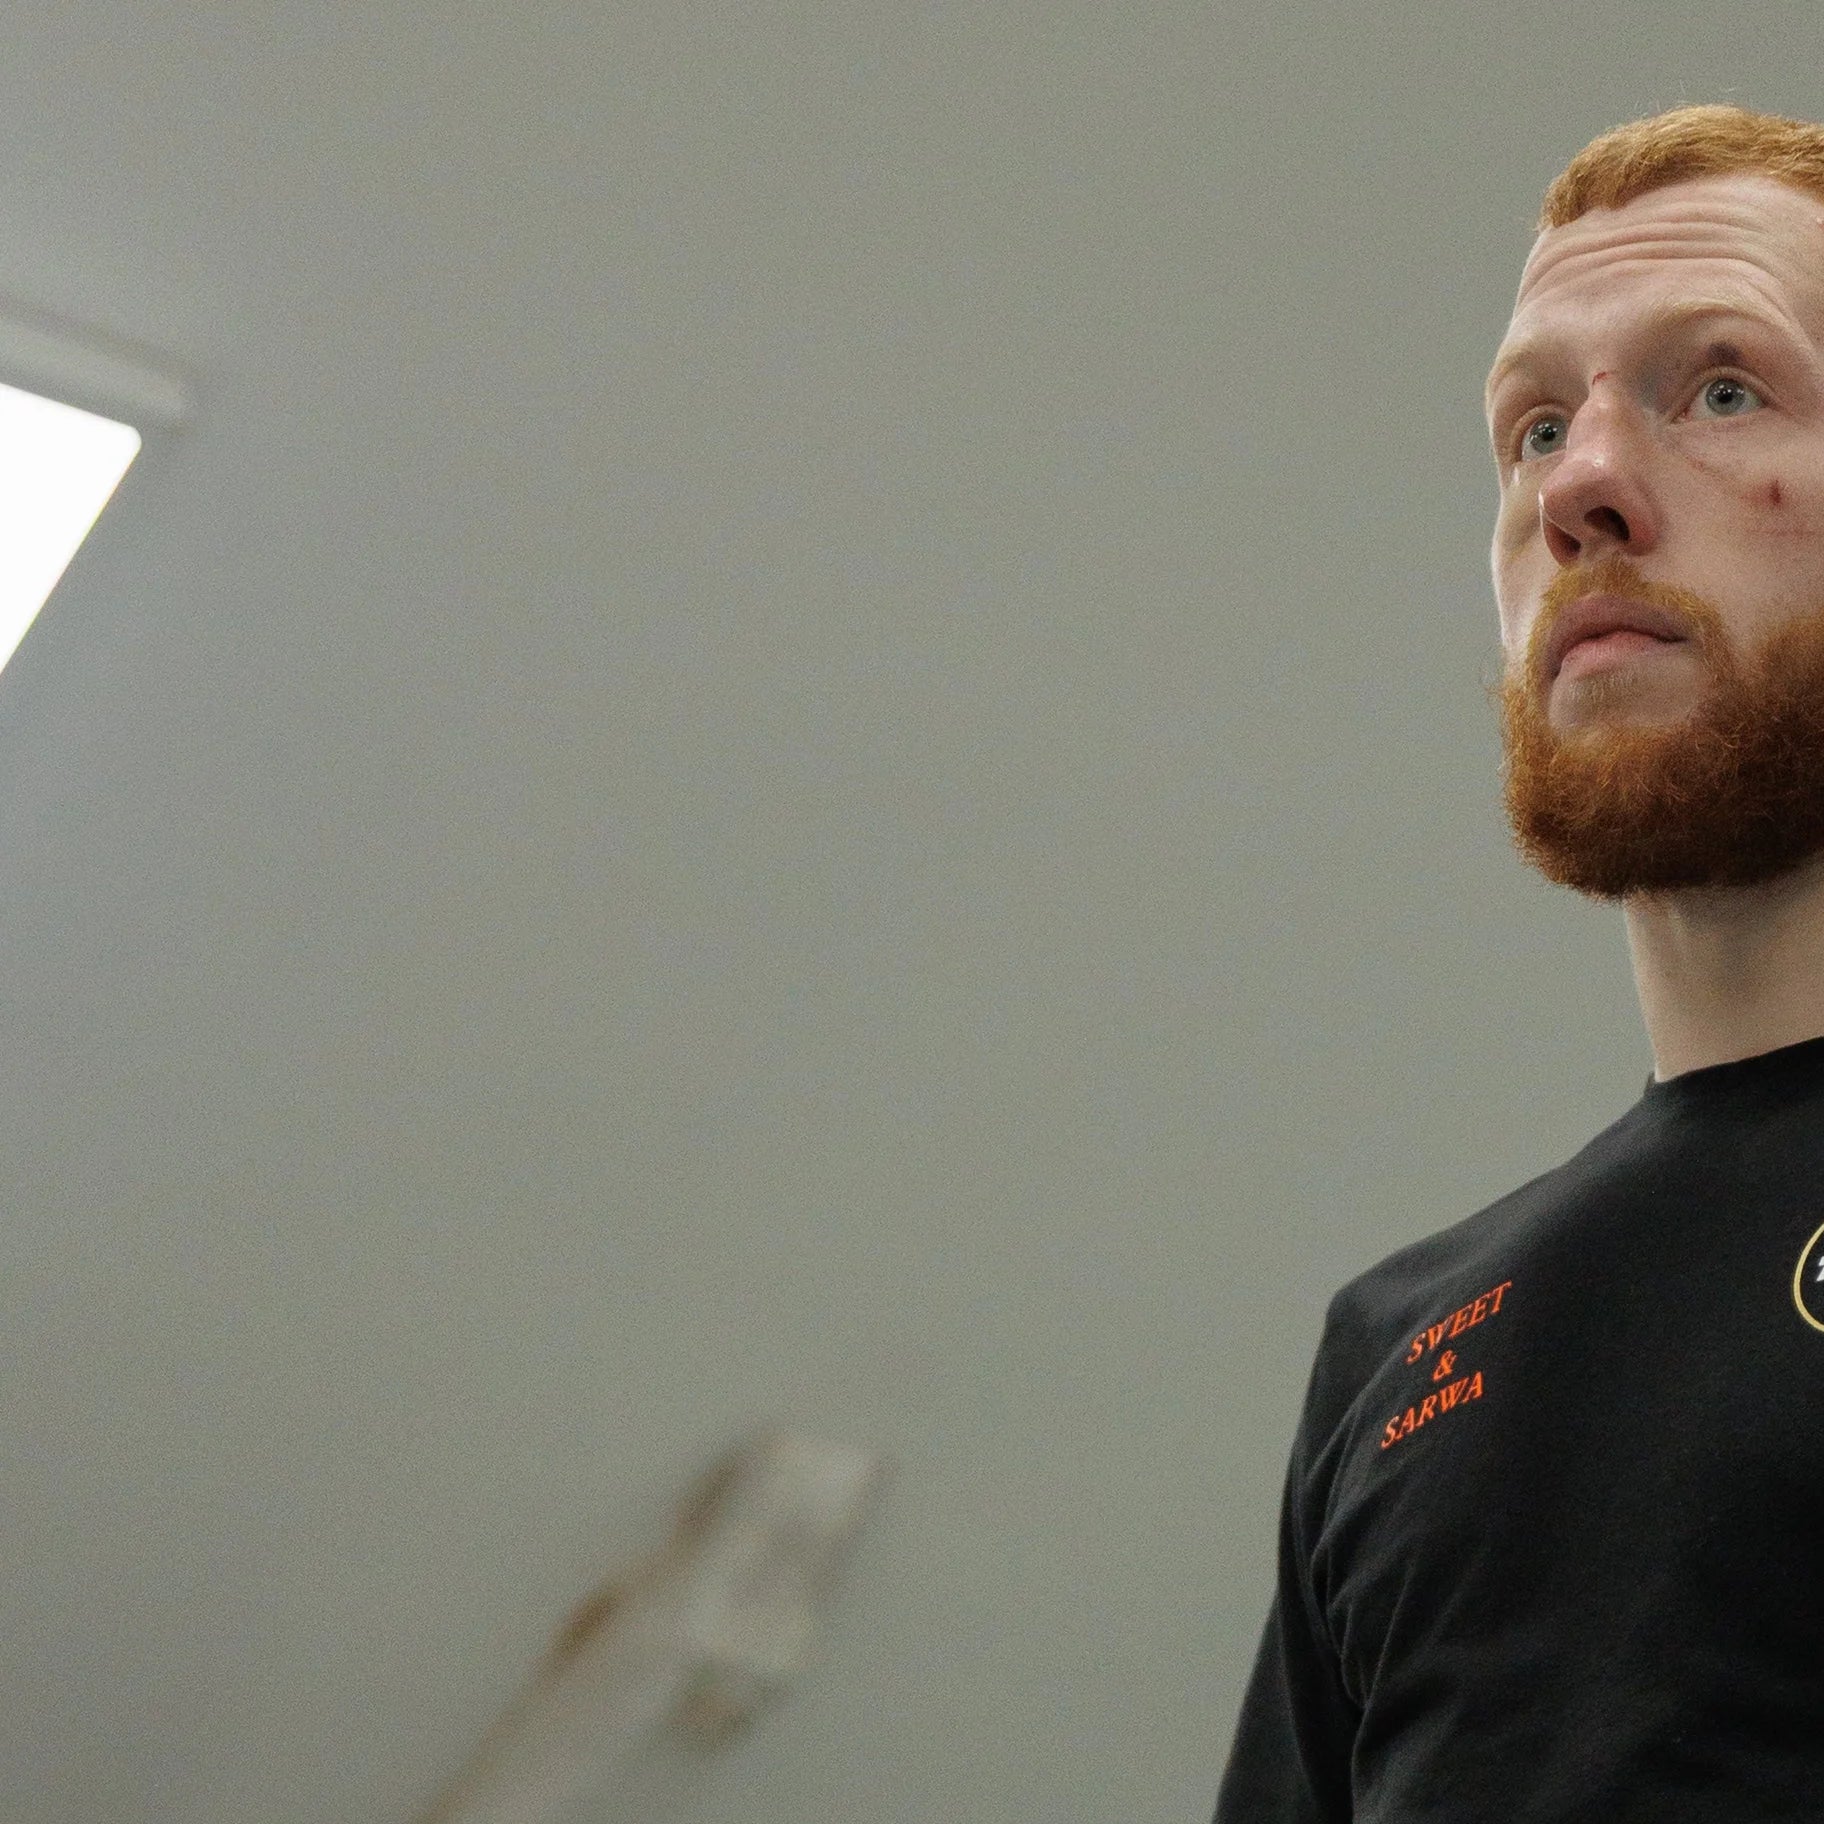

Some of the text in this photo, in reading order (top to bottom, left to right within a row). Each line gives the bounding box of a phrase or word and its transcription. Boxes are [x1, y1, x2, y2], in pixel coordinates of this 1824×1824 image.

[1406, 1279, 1513, 1365] SWEET
[1432, 1349, 1457, 1382] &
[1380, 1371, 1484, 1450] SARWA
